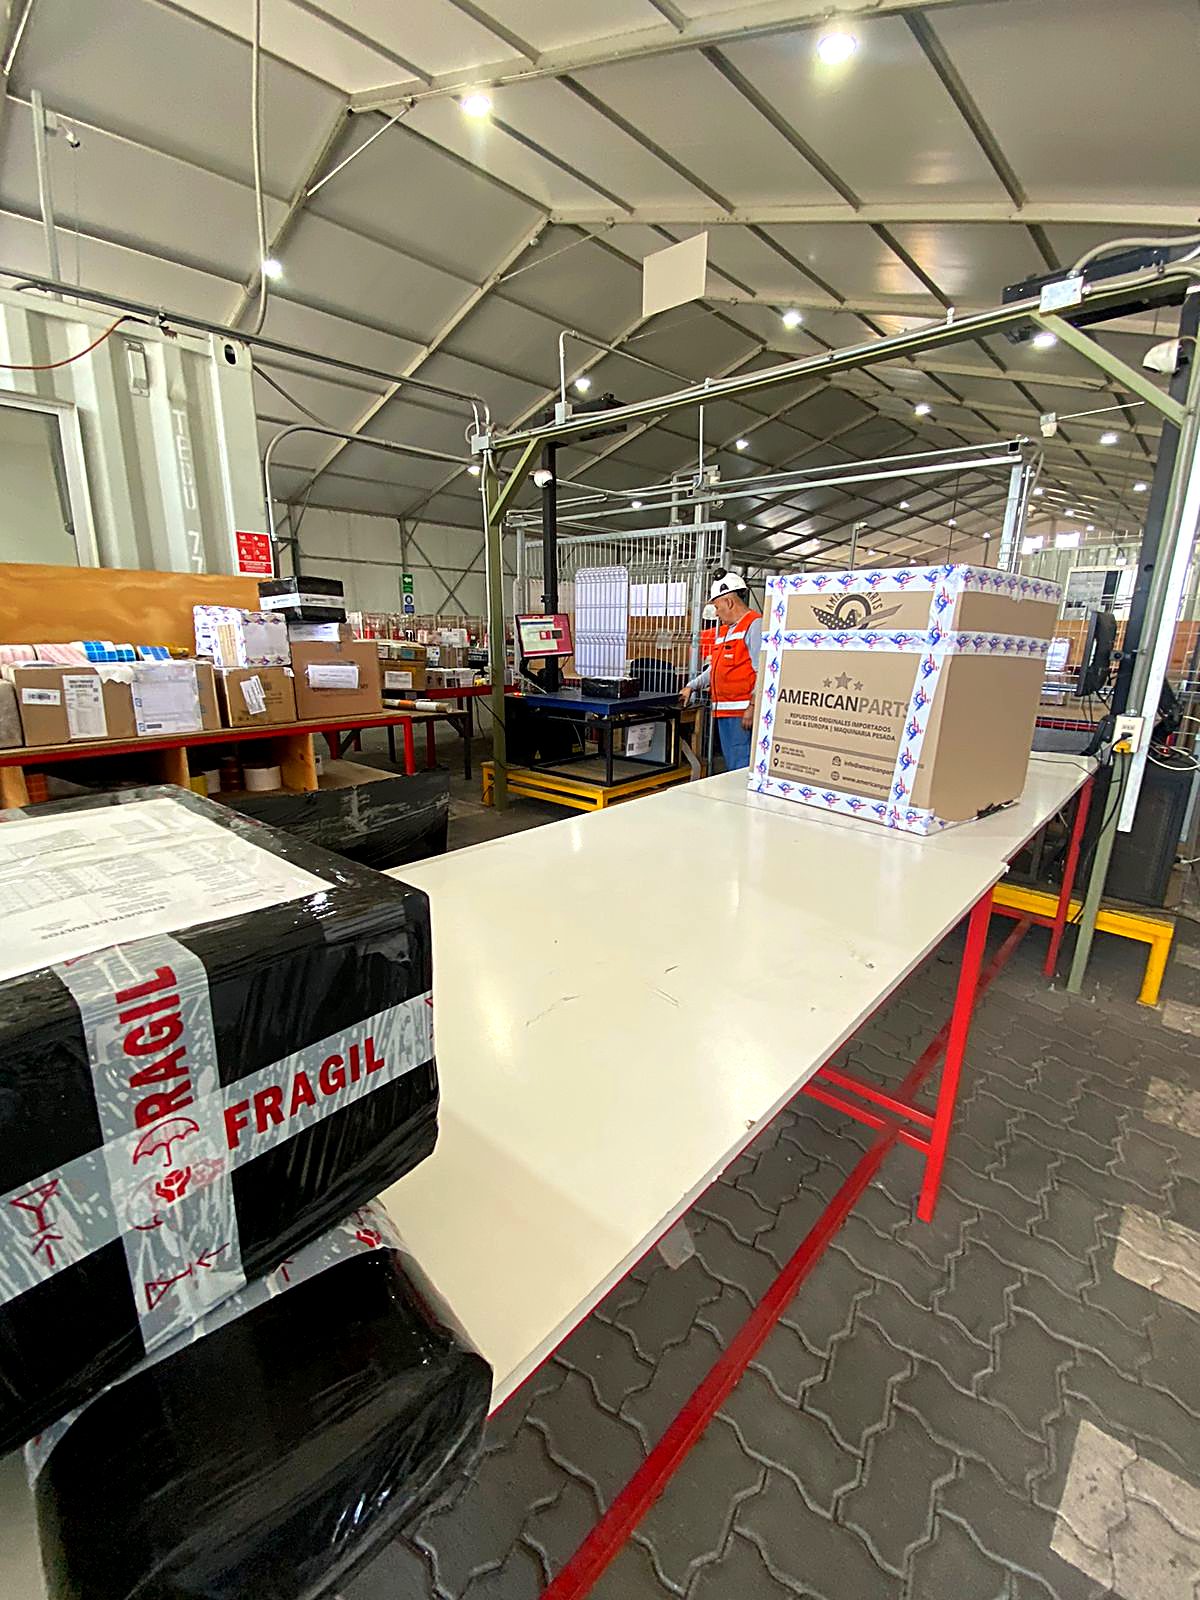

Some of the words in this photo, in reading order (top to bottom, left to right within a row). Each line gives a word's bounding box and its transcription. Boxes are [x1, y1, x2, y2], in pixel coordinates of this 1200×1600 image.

[790, 712, 818, 722] REPUESTOS
[819, 716, 851, 727] ORIGINALES
[852, 721, 891, 733] IMPORTADOS
[807, 722, 829, 730] EUROPA
[833, 726, 871, 738] MAQUINARIA
[872, 732, 896, 742] PESADA
[115, 965, 194, 1129] RAGIL
[223, 1037, 385, 1150] FRAGIL
